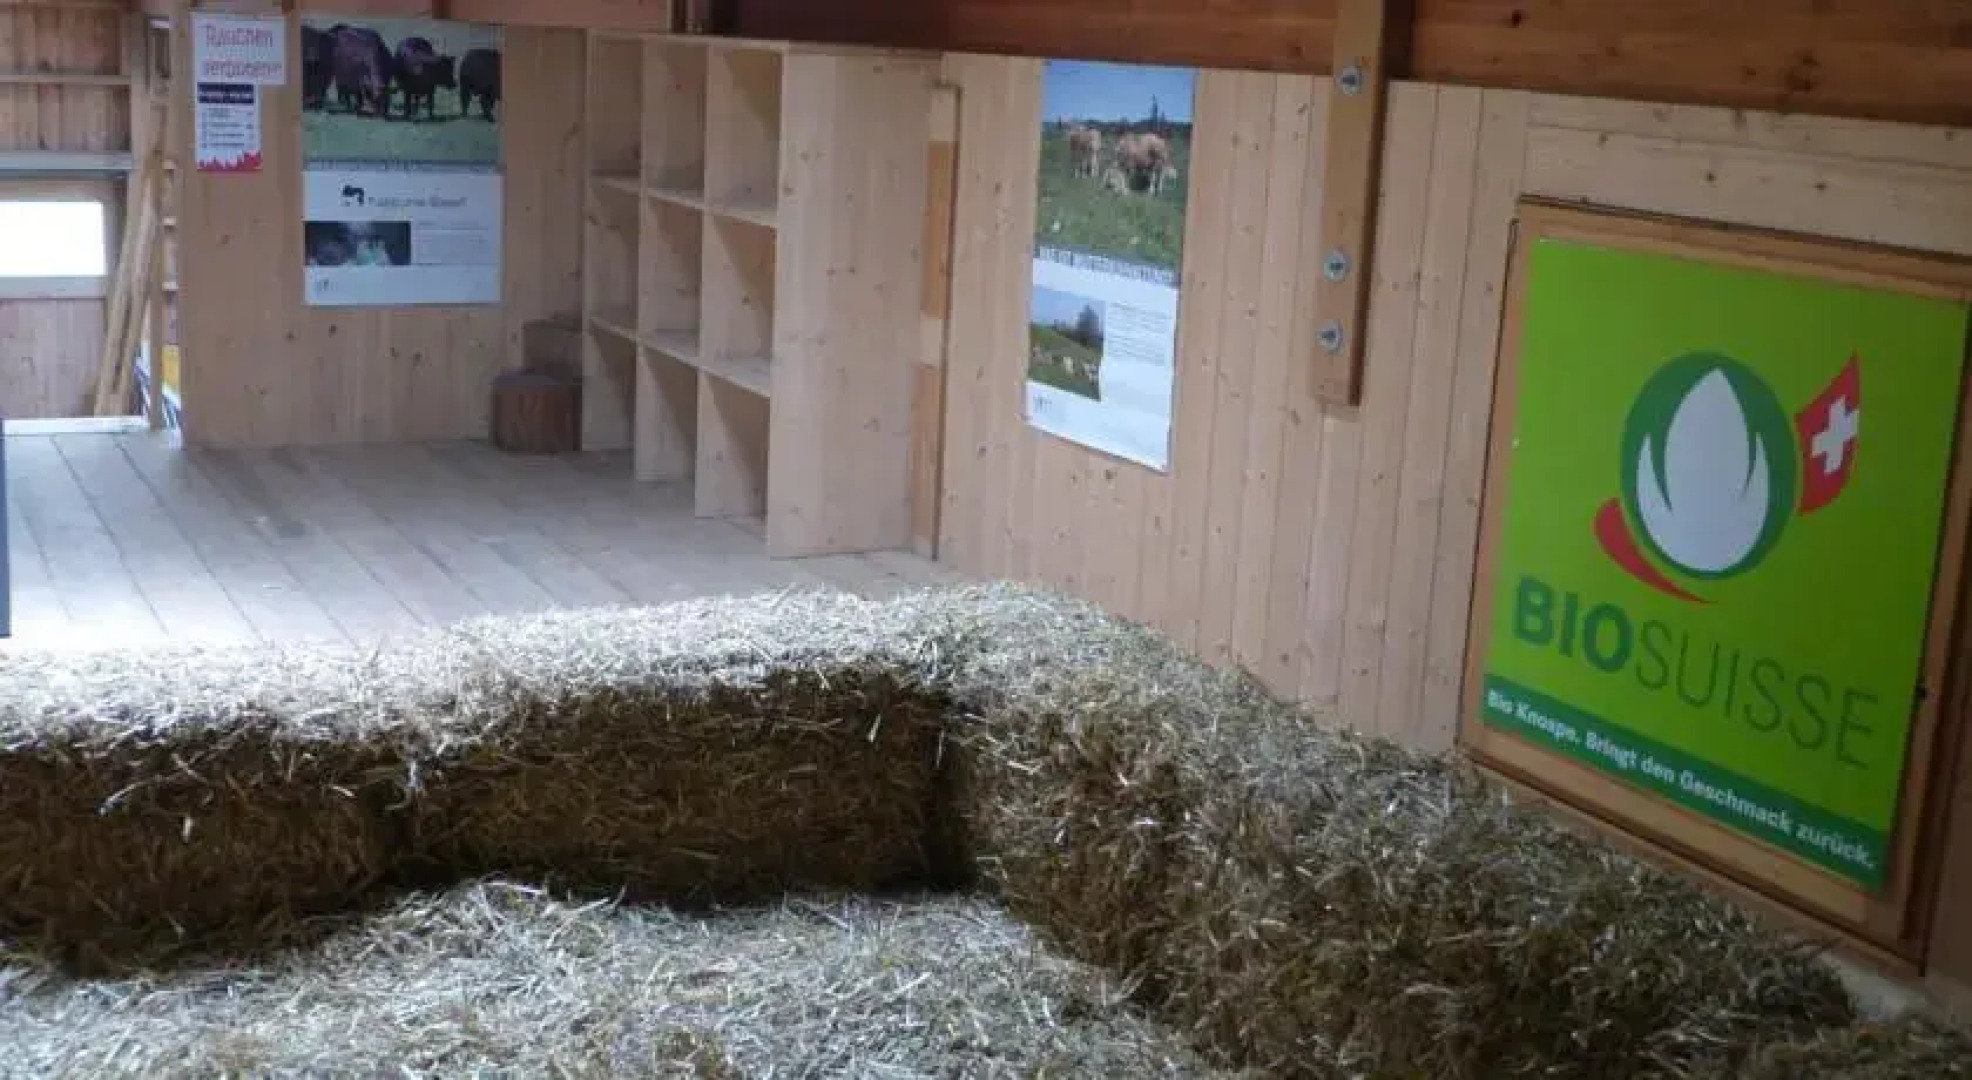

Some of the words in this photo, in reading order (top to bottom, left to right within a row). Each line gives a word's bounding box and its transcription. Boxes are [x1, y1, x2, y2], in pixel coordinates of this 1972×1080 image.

[1487, 688, 1513, 715] Bio
[1515, 703, 1581, 744] Knospe.
[1586, 731, 1637, 769] Bringt
[1641, 755, 1676, 784] den
[1680, 770, 1794, 837] Geschmack
[1795, 823, 1876, 870] zurück.
